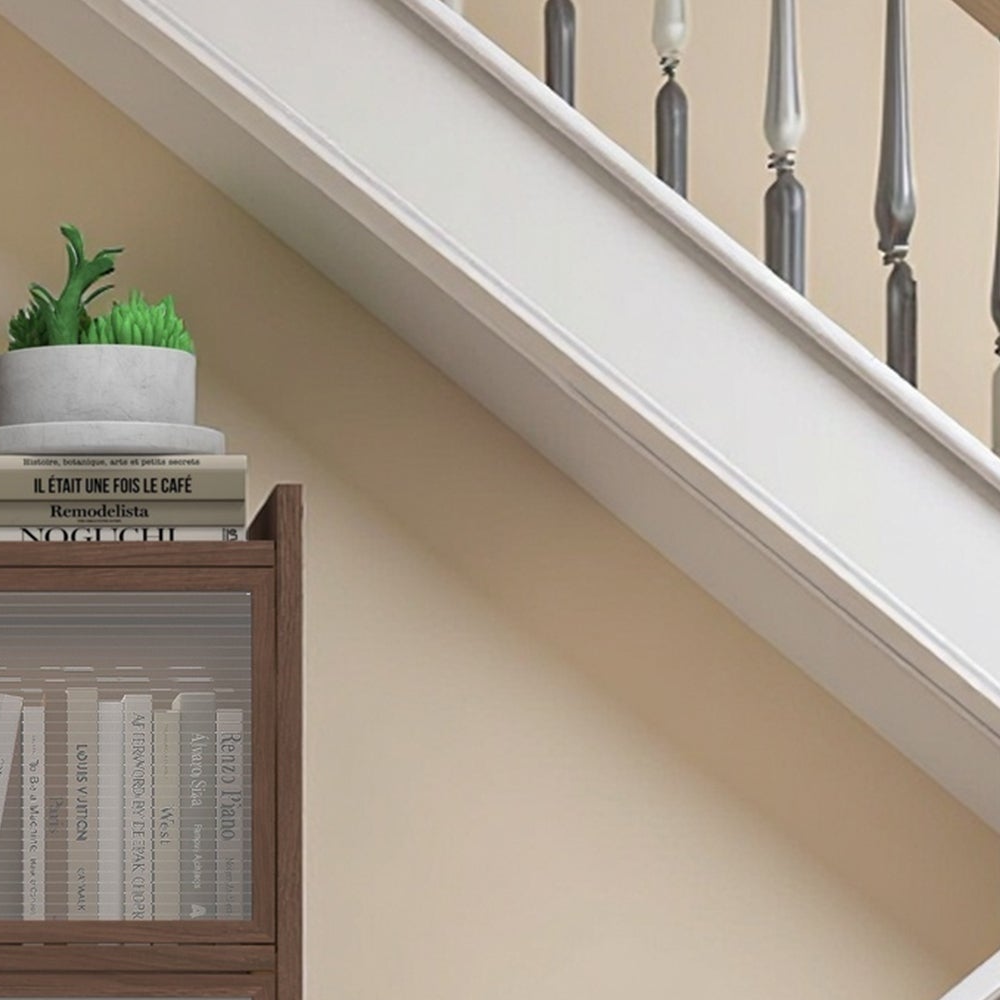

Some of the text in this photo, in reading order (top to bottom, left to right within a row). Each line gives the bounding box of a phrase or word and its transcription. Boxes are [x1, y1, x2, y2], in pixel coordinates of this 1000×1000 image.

[110, 458, 128, 467] arts
[130, 458, 140, 467] et
[141, 457, 167, 468] petits
[168, 458, 201, 467] secrets
[34, 475, 192, 494] IL ÉTAIT UNE FOIS LE CAFÉ
[50, 504, 149, 519] Remodelista
[76, 744, 88, 783] LOUIS
[221, 732, 241, 784] Renzo
[160, 806, 174, 845] West
[221, 791, 241, 841] Piano
